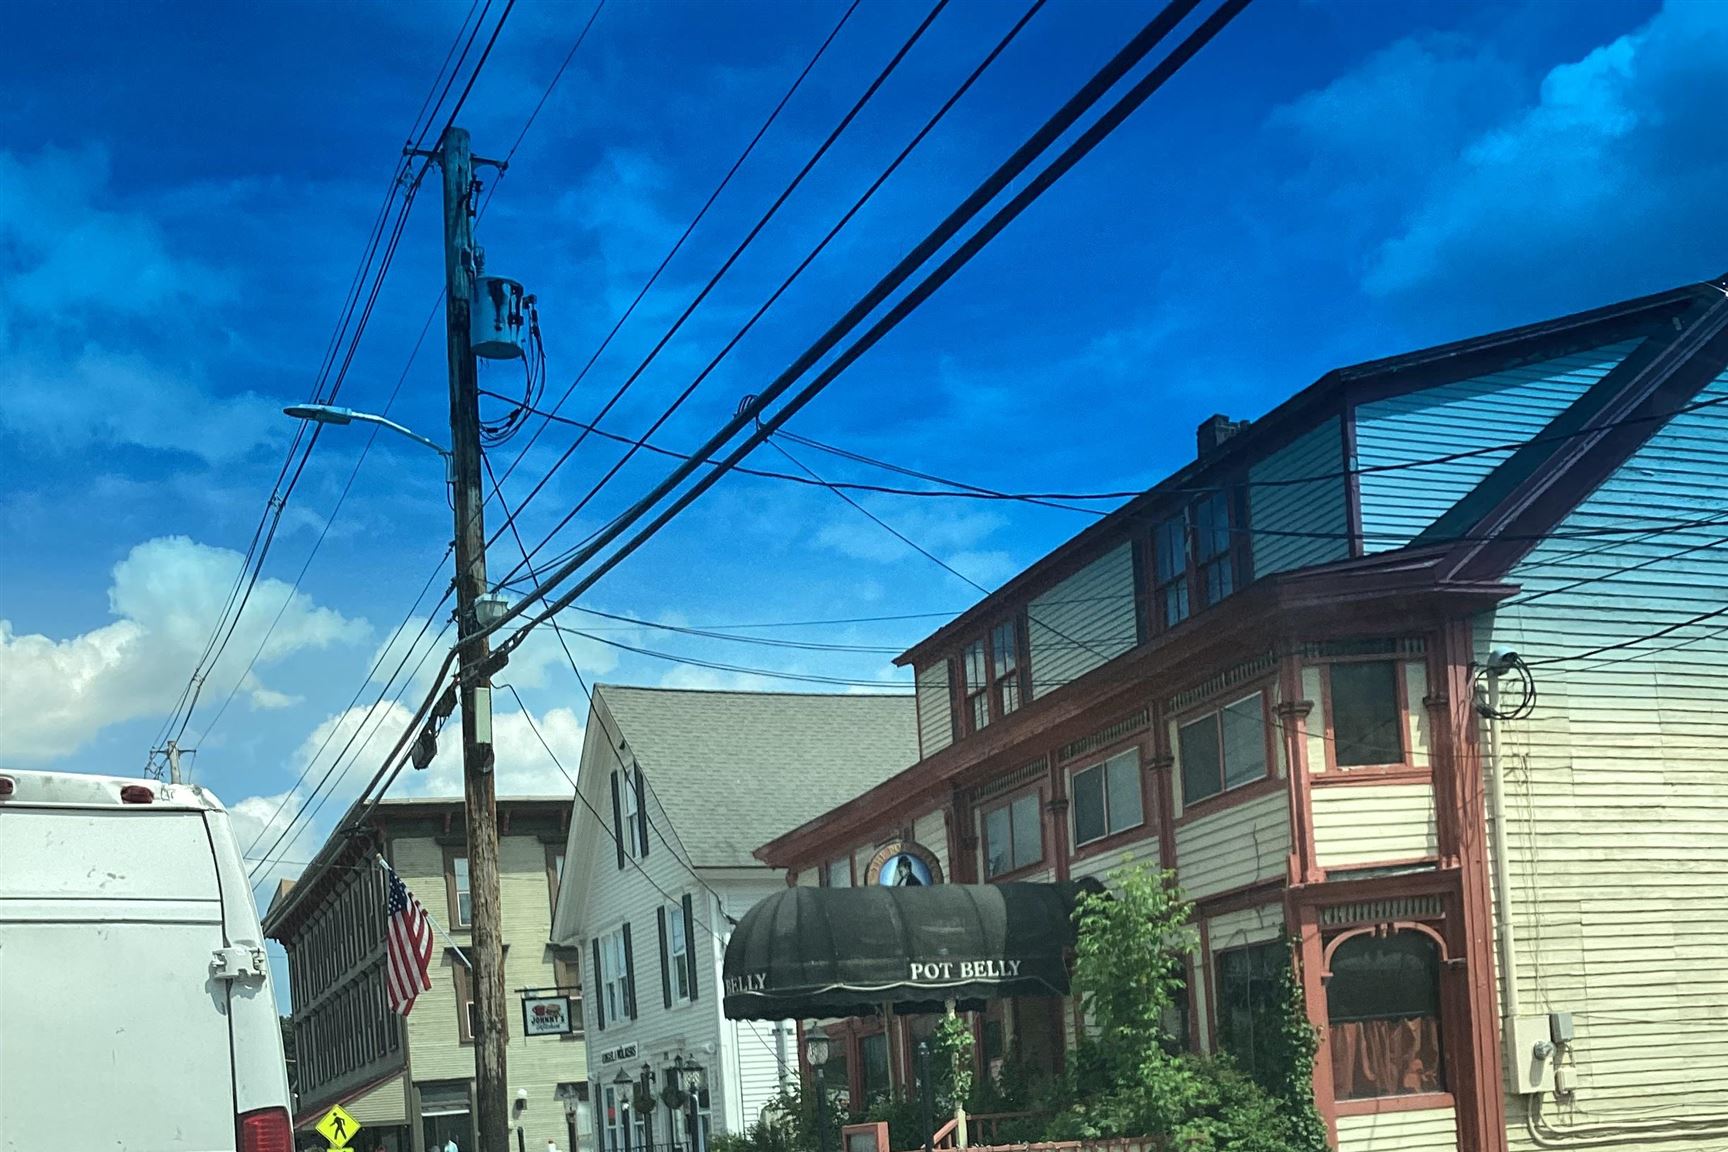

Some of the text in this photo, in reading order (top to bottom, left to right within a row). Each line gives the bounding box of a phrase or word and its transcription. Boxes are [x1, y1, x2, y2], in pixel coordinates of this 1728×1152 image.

[910, 960, 1021, 980] POT BELLY
[725, 972, 766, 996] BELLY
